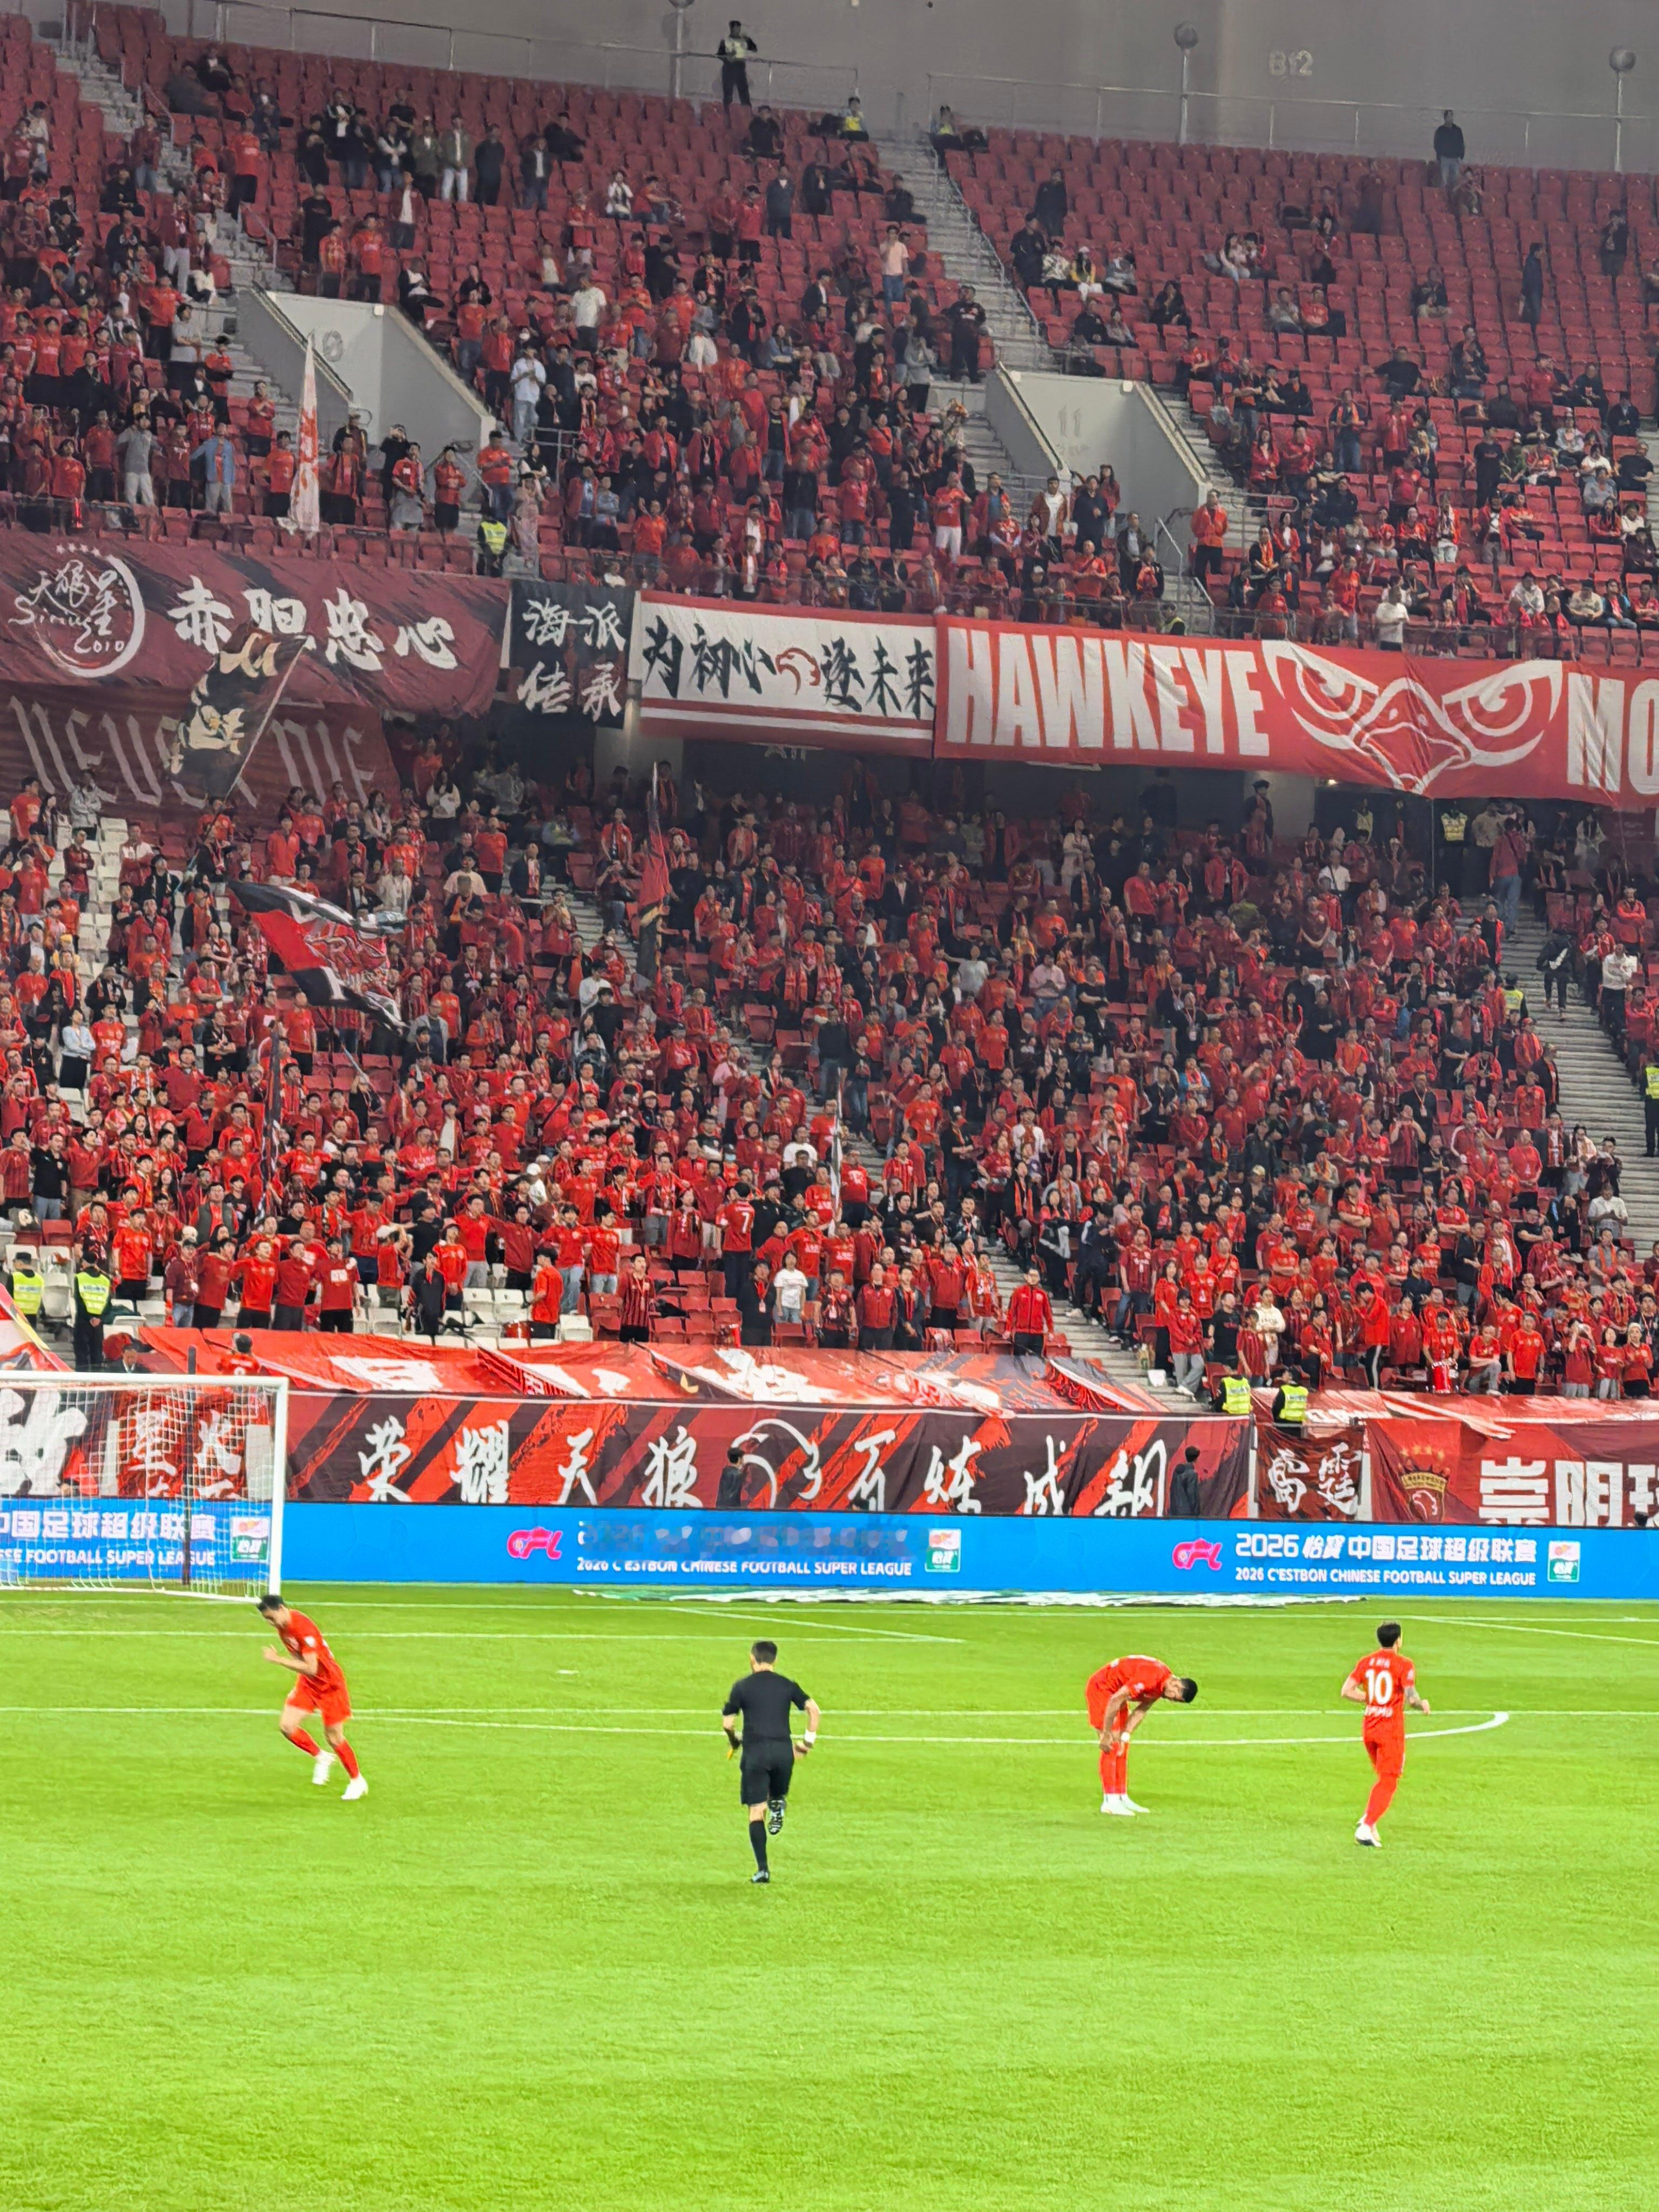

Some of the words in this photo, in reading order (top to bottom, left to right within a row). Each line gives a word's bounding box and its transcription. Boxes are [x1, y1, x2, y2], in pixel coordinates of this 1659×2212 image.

[946, 627, 1270, 756] HAWKEYE
[1235, 1533, 1299, 1558] 2026
[27, 1549, 103, 1564] FOOTBALL
[106, 1549, 155, 1565] SUPER
[741, 1561, 811, 1574] FOOTBALL
[814, 1562, 857, 1575] SUPER
[860, 1562, 912, 1576] LEAGUE
[1235, 1567, 1264, 1581] 2026
[1267, 1568, 1327, 1582] C'ESTBON
[1330, 1568, 1381, 1583] CHINESE
[1383, 1569, 1446, 1584] FOOTBALL
[1448, 1570, 1488, 1585] SUPER
[1489, 1572, 1536, 1586] LEAGUE
[1365, 1669, 1393, 1705] 10
